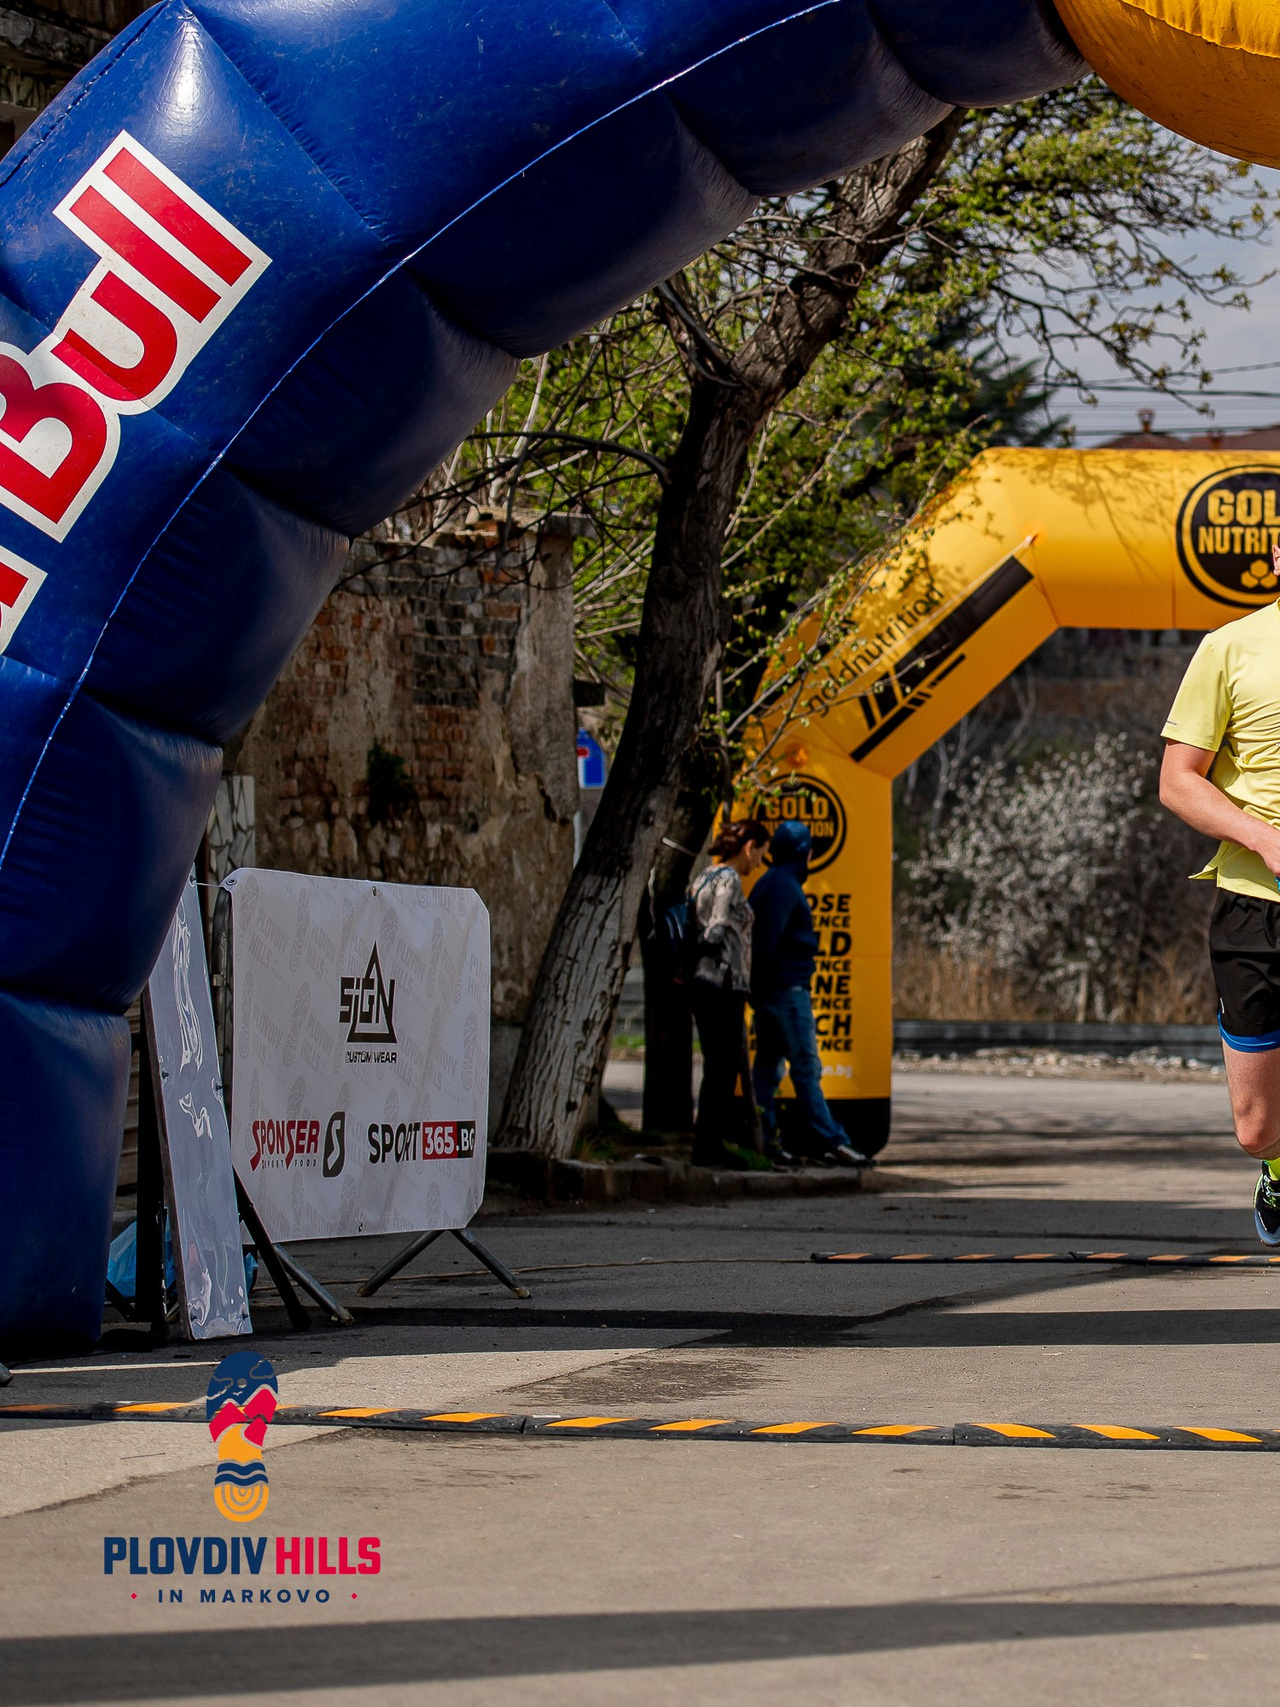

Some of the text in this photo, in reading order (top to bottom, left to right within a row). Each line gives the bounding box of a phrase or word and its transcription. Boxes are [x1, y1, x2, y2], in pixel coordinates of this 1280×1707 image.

[766, 796, 828, 819] GOLD
[373, 1051, 397, 1063] WEAR
[250, 1119, 320, 1172] SPONSER
